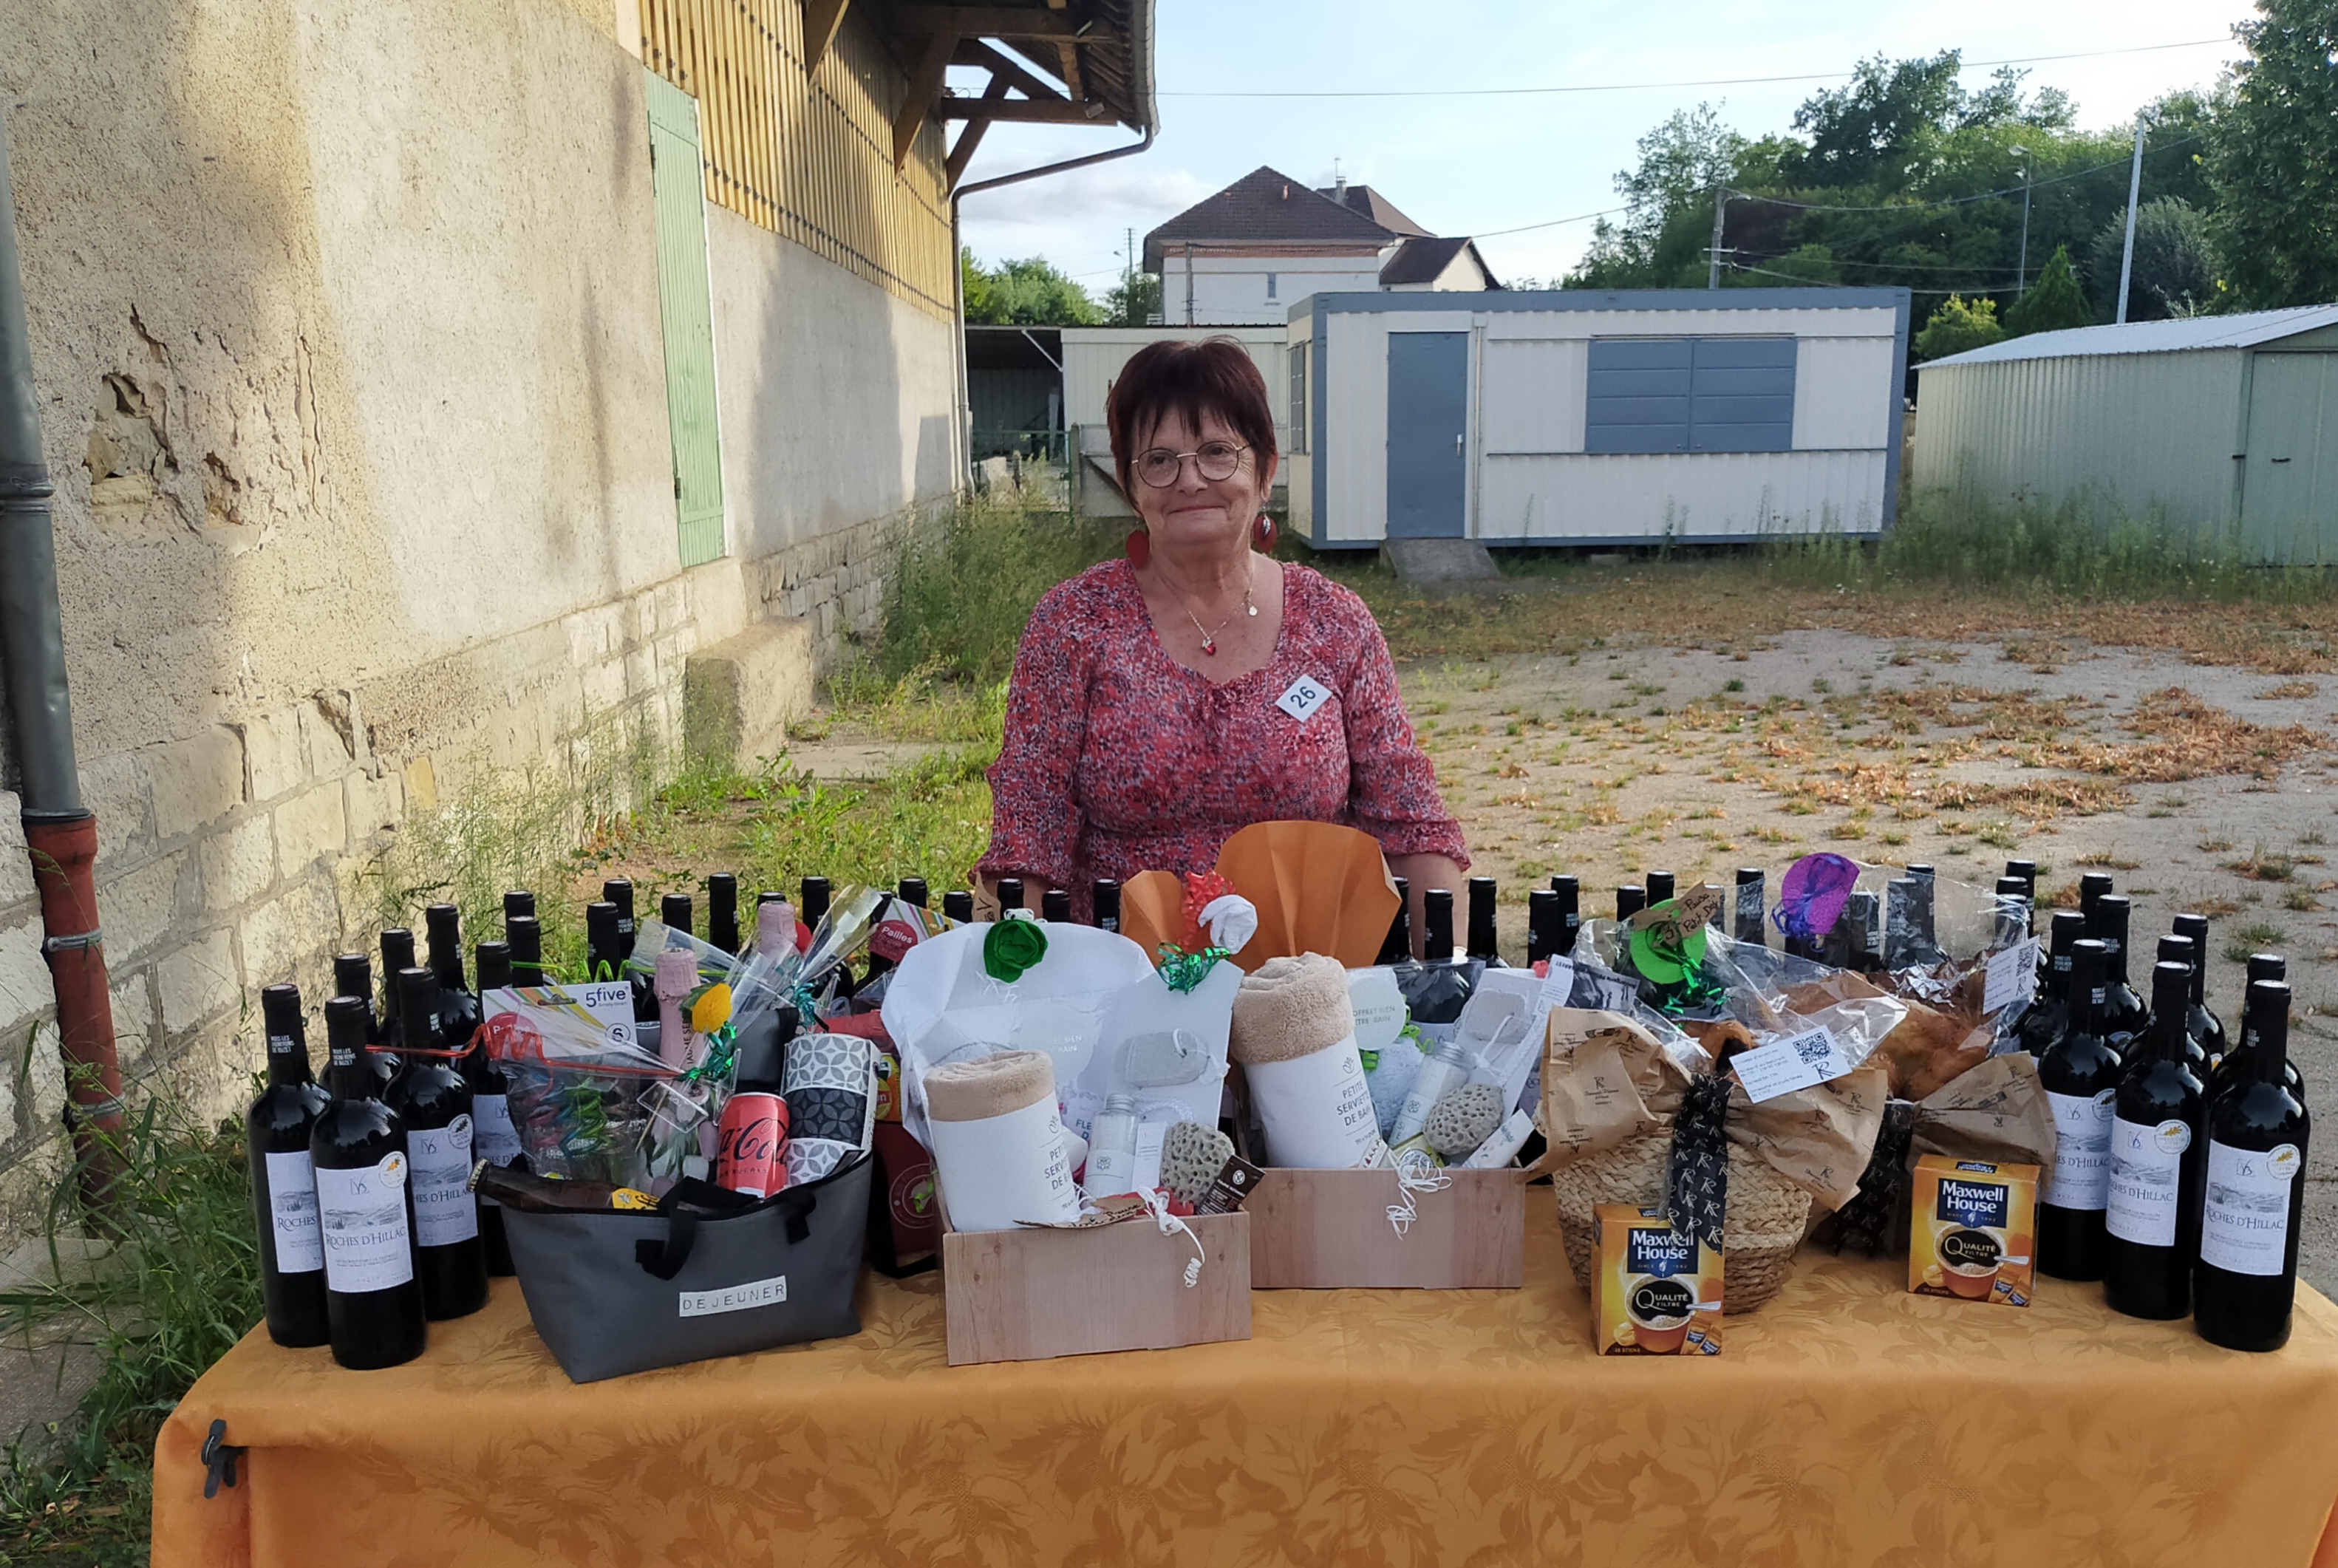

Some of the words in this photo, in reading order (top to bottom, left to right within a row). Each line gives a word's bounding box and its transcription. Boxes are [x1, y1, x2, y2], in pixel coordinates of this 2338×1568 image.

[1290, 686, 1316, 709] 26
[882, 927, 913, 944] Pailles
[1353, 1007, 1377, 1017] OFFRET
[1342, 1080, 1363, 1099] PETITE
[1344, 1114, 1357, 1127] DE
[1052, 1176, 1063, 1190] DE
[1943, 1180, 2003, 1201] Maxwell
[2128, 1188, 2173, 1201] D'HILLAC
[1947, 1196, 1997, 1213] House
[277, 1216, 316, 1232] ROCHES
[2237, 1217, 2284, 1230] D'HILLAC
[326, 1233, 359, 1250] ROCHES
[362, 1227, 406, 1246] D'HILLAC
[1637, 1247, 1688, 1260] House
[1945, 1236, 1997, 1259] QUALITÉ
[1636, 1289, 1688, 1311] QUALITÉ
